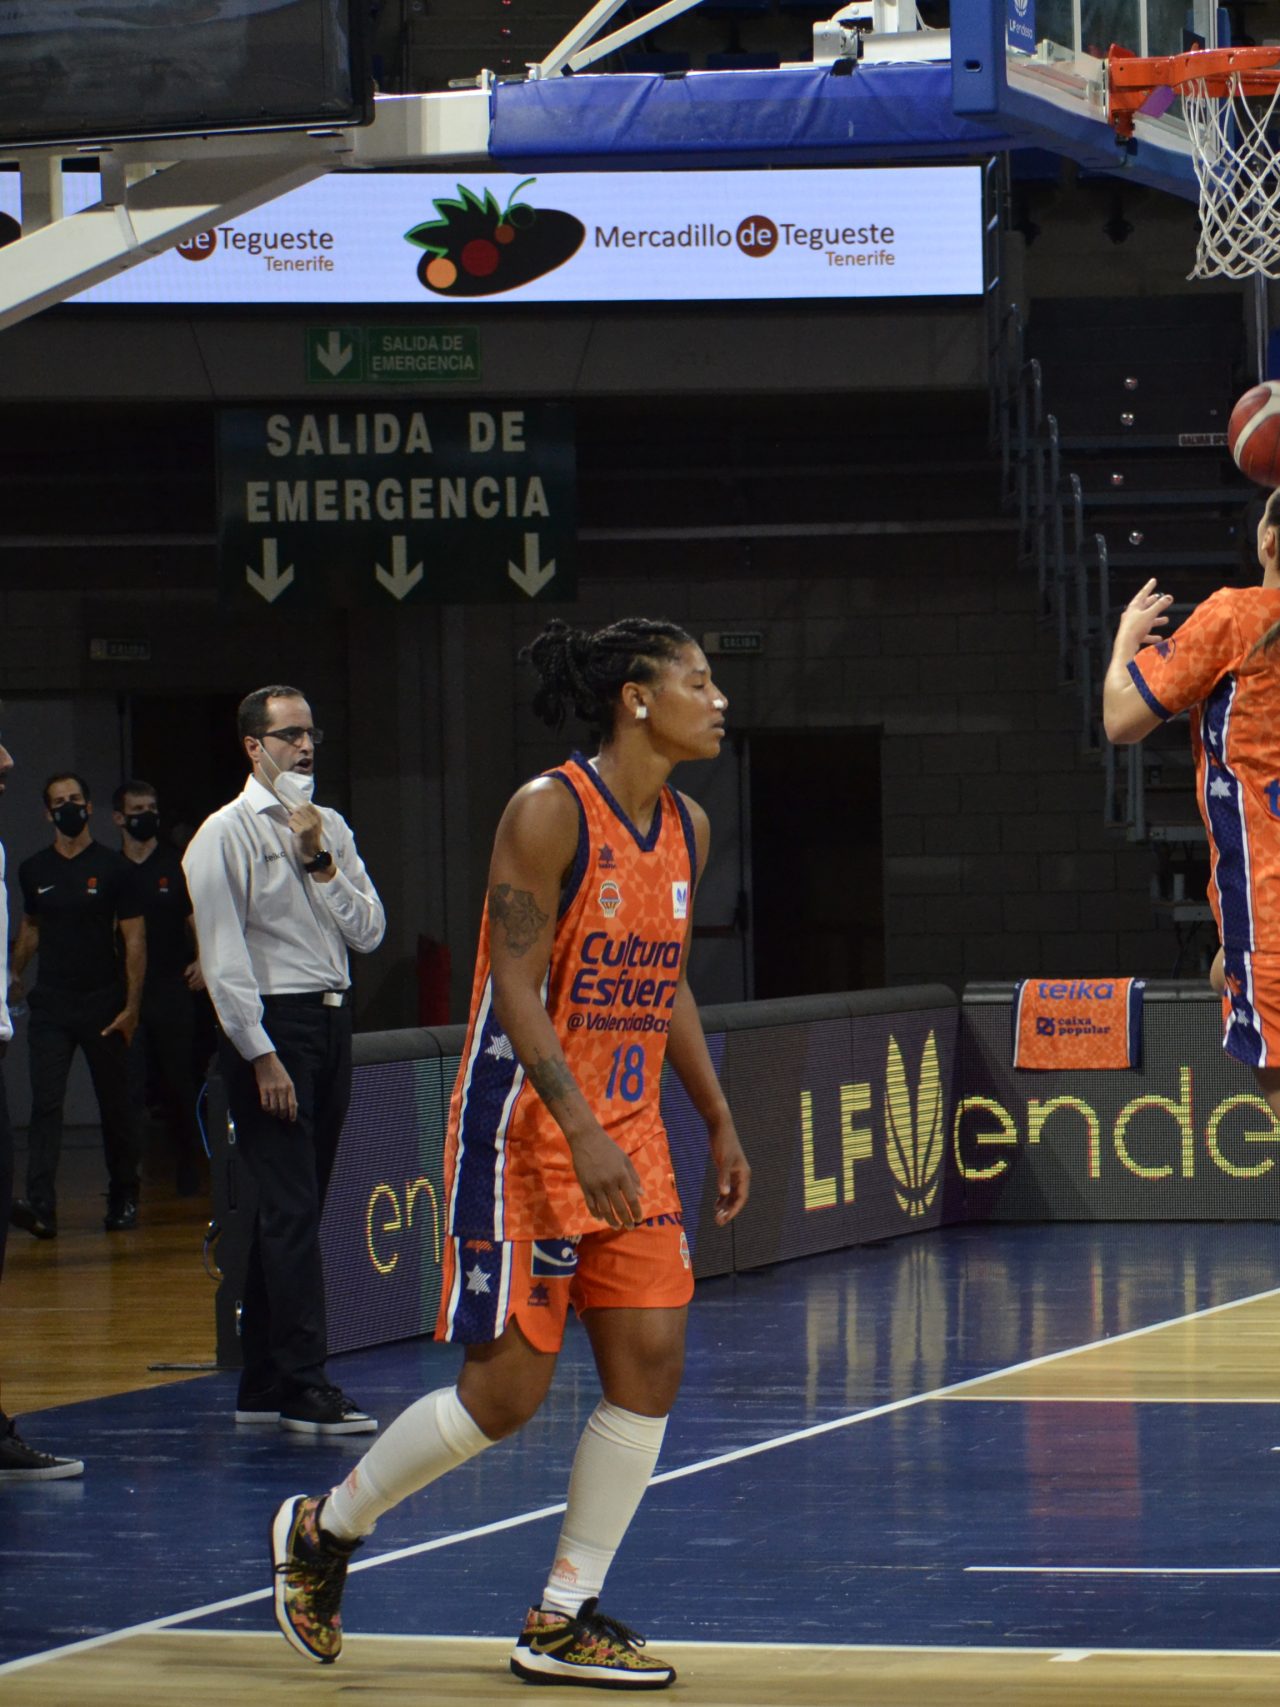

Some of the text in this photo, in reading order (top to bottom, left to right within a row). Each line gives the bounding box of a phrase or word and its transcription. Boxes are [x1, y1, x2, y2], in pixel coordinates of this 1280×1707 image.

[218, 228, 334, 254] Tegueste
[594, 221, 895, 251] Mercadillo de Tegueste
[264, 256, 334, 271] Tenerife
[825, 250, 896, 268] Tenerife
[382, 335, 463, 351] SALIDA DE
[372, 355, 475, 371] EMERGENCIA
[266, 411, 526, 456] SALIDA DE
[247, 476, 549, 523] EMERGENCIA
[581, 931, 681, 968] Cultura
[1038, 980, 1114, 1000] teika
[1058, 1017, 1092, 1026] caixa
[1058, 1026, 1111, 1036] popular
[605, 1043, 645, 1102] 18
[801, 1082, 873, 1211] LF
